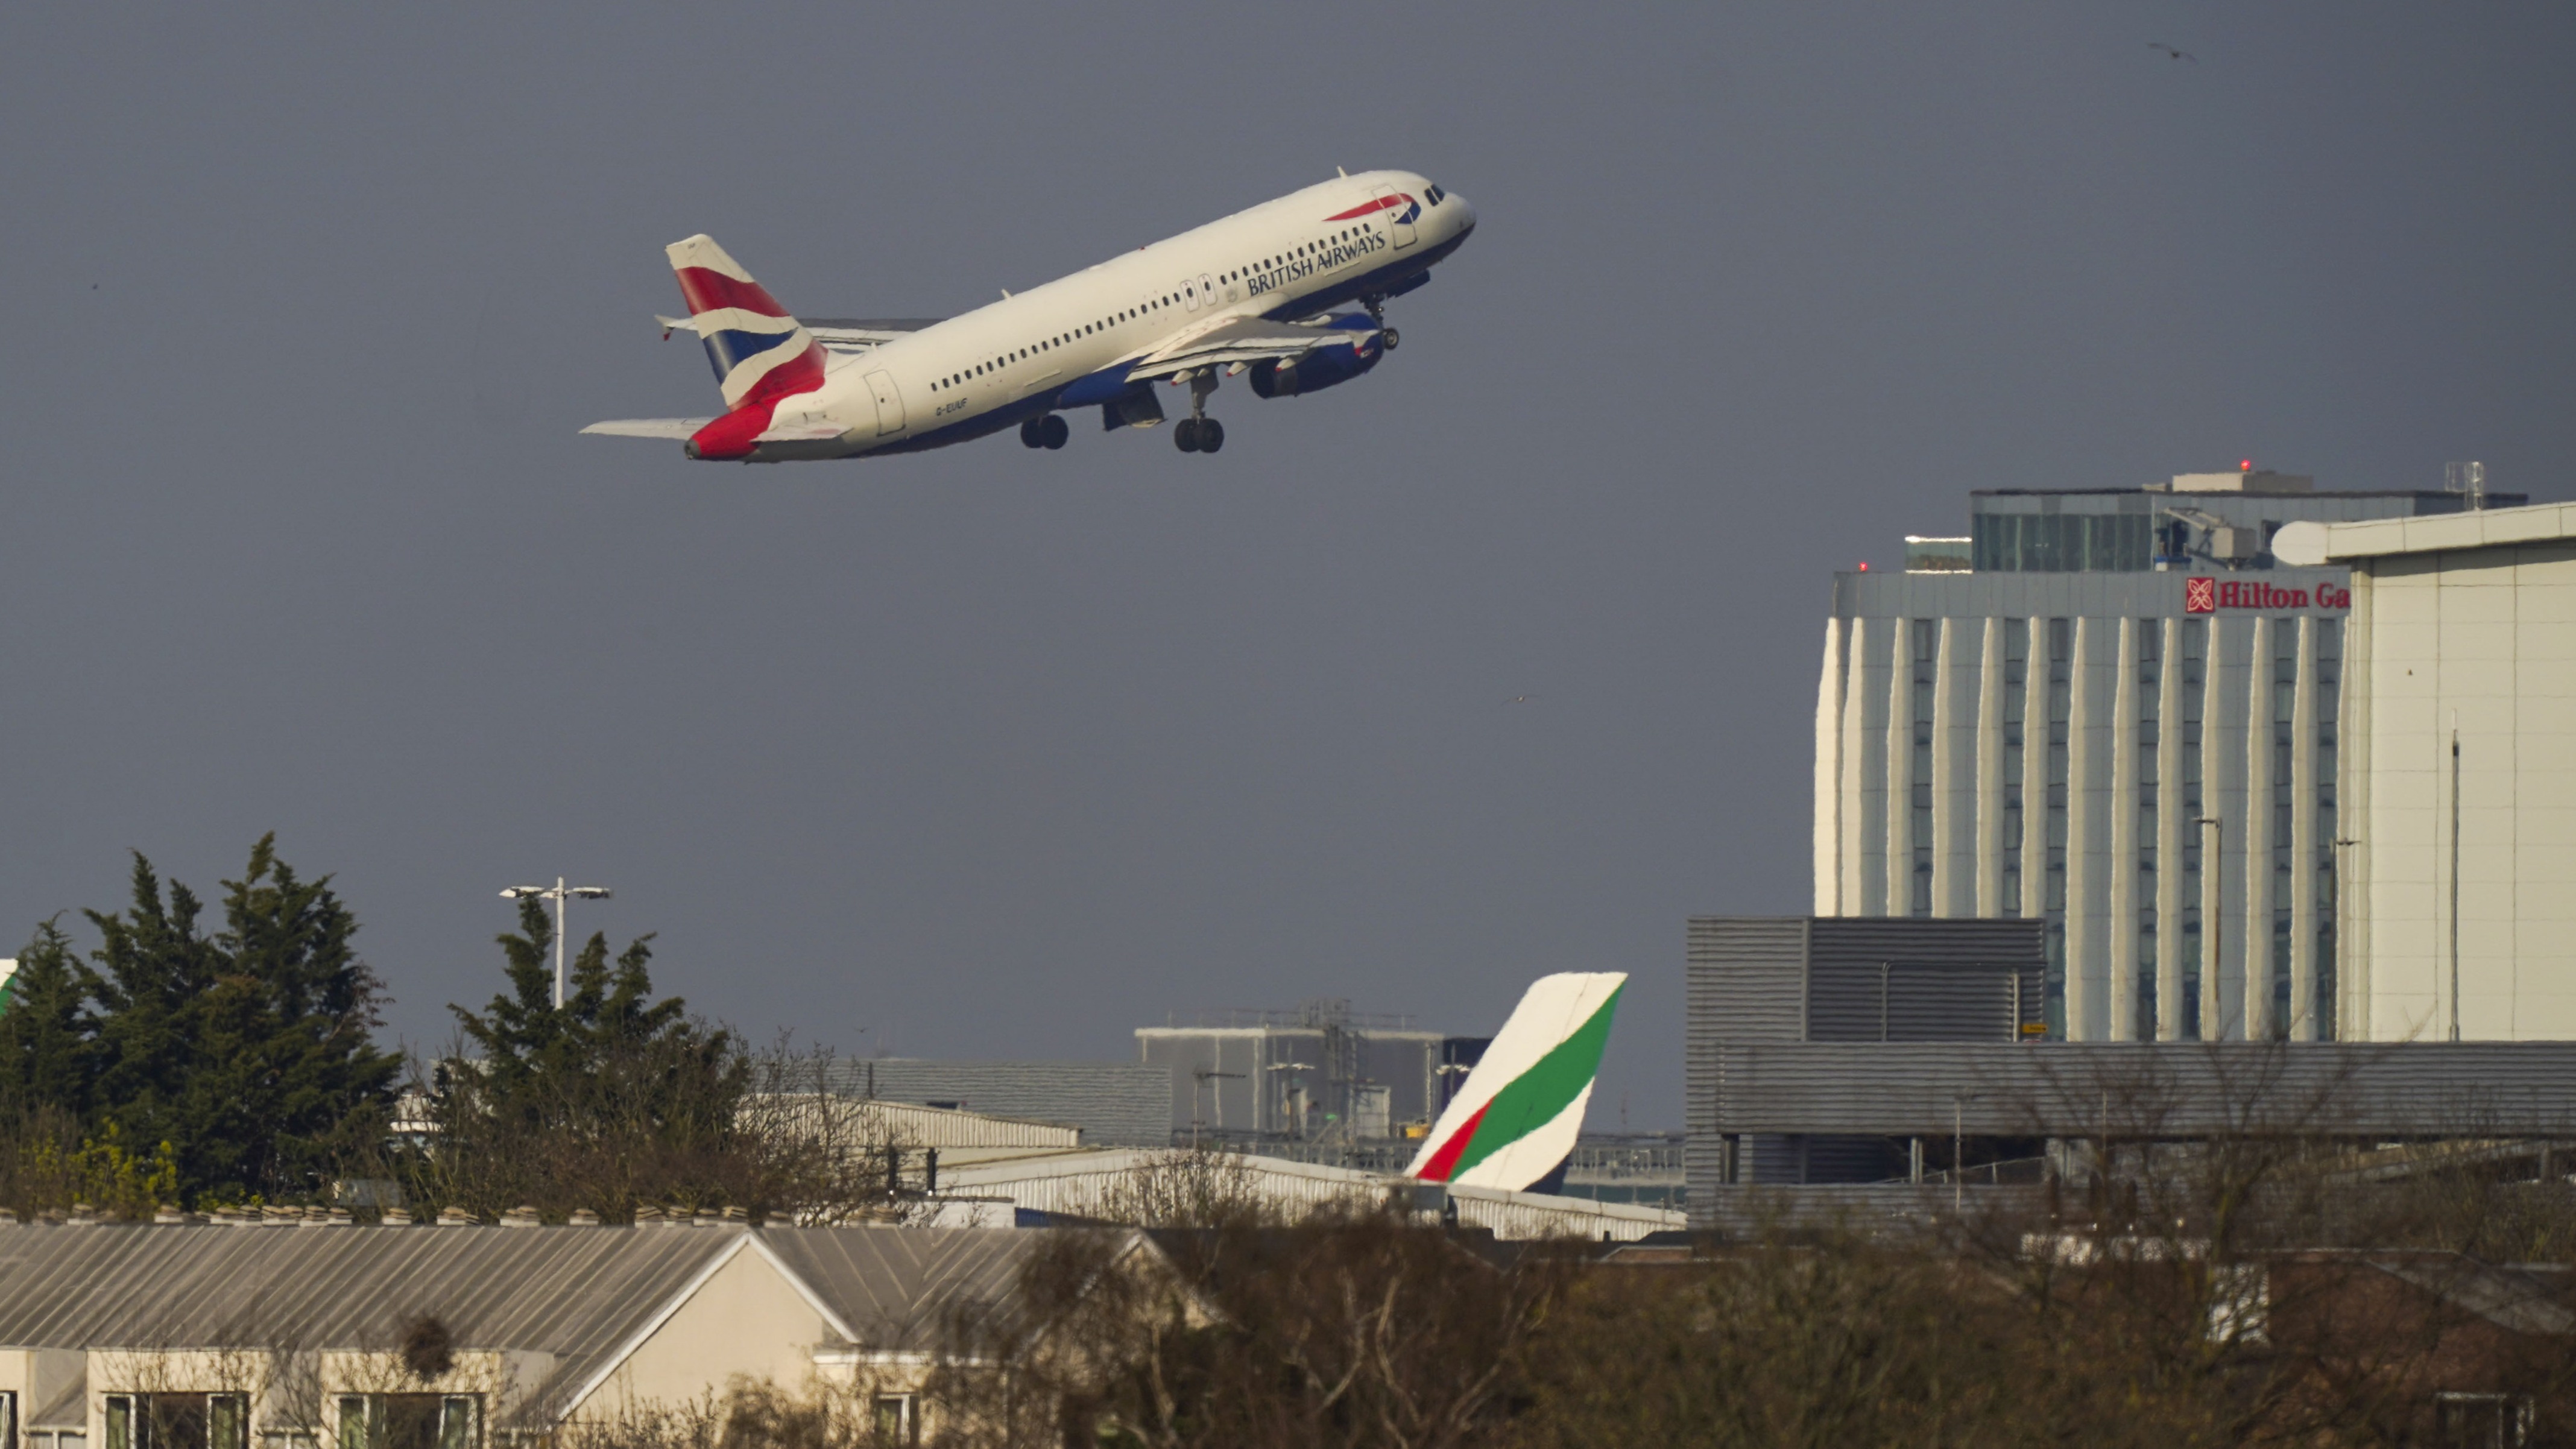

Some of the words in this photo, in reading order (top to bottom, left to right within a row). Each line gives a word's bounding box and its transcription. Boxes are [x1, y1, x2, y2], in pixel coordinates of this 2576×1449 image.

[1248, 258, 1313, 296] BRITISH
[1317, 231, 1386, 271] AIRWAYS
[2218, 581, 2309, 609] Hilton
[2315, 581, 2350, 609] Ga
